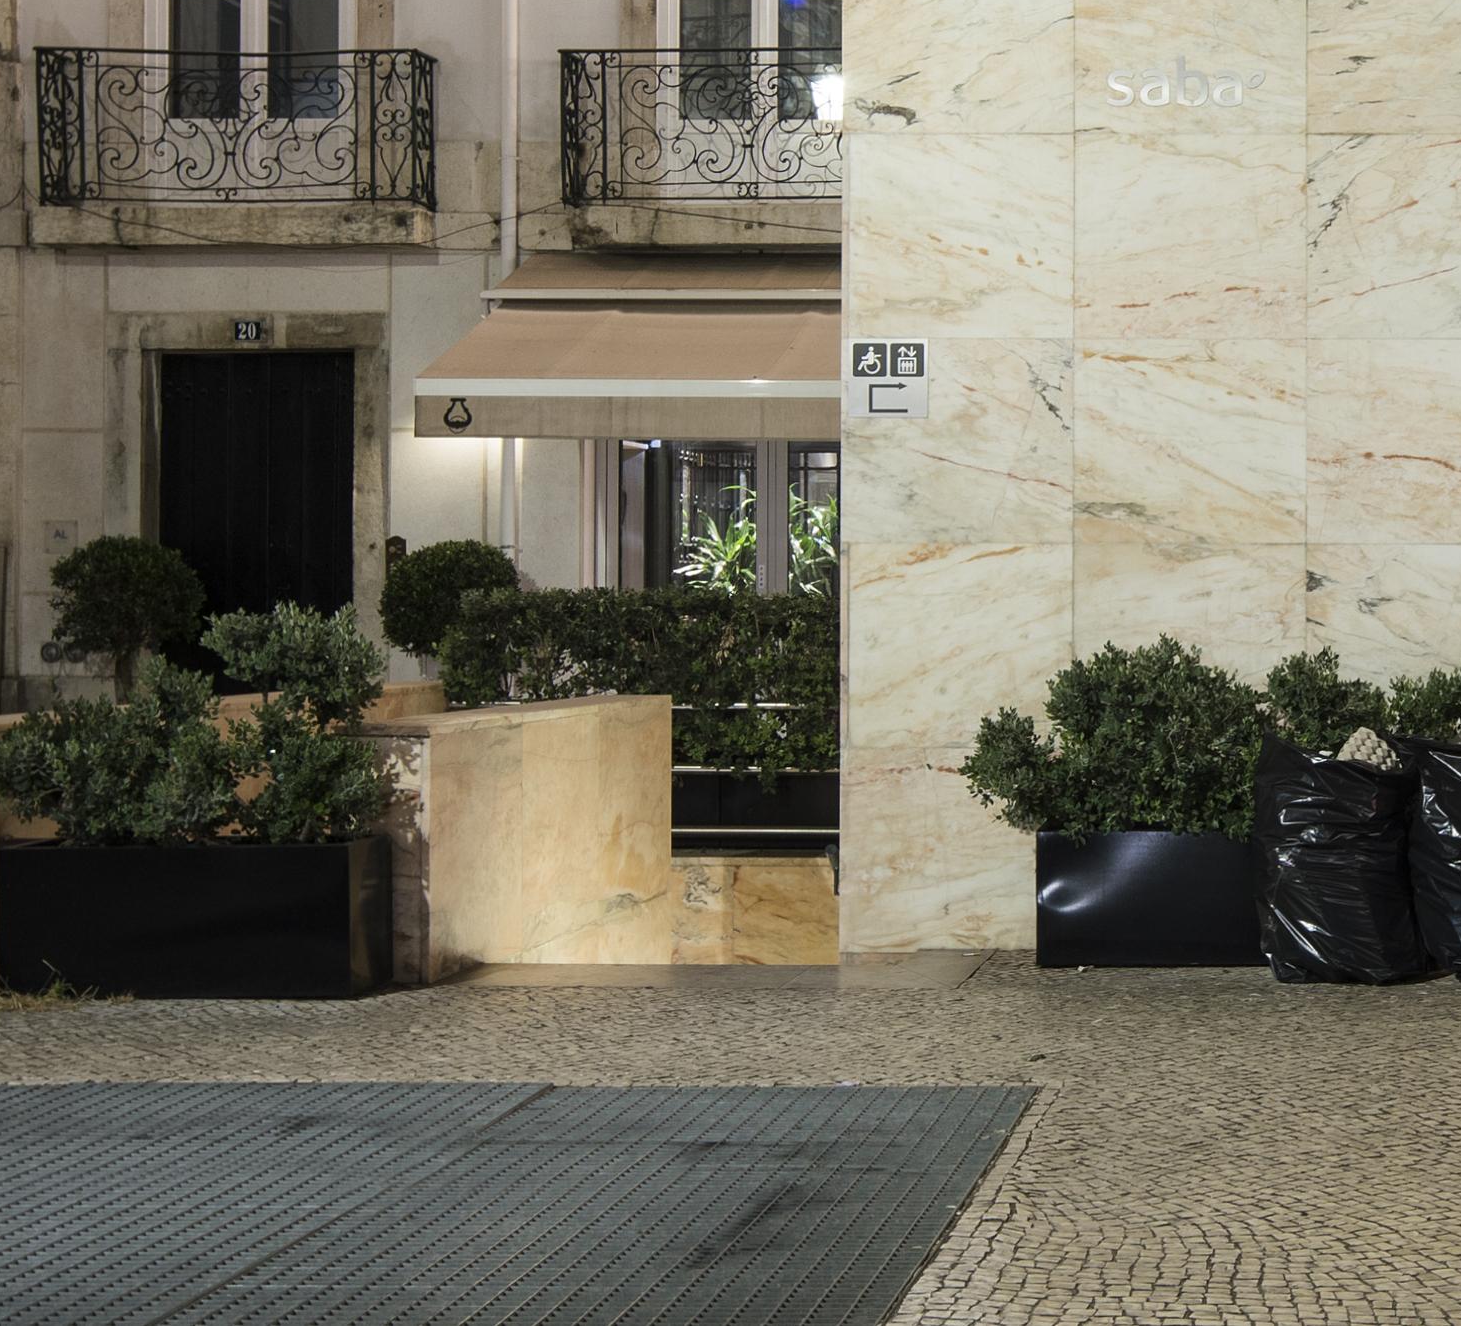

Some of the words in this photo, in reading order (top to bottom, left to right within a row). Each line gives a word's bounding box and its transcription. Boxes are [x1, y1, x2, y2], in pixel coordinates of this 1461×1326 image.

[1105, 53, 1244, 108] saba
[237, 322, 257, 340] 20
[53, 529, 68, 540] AL
